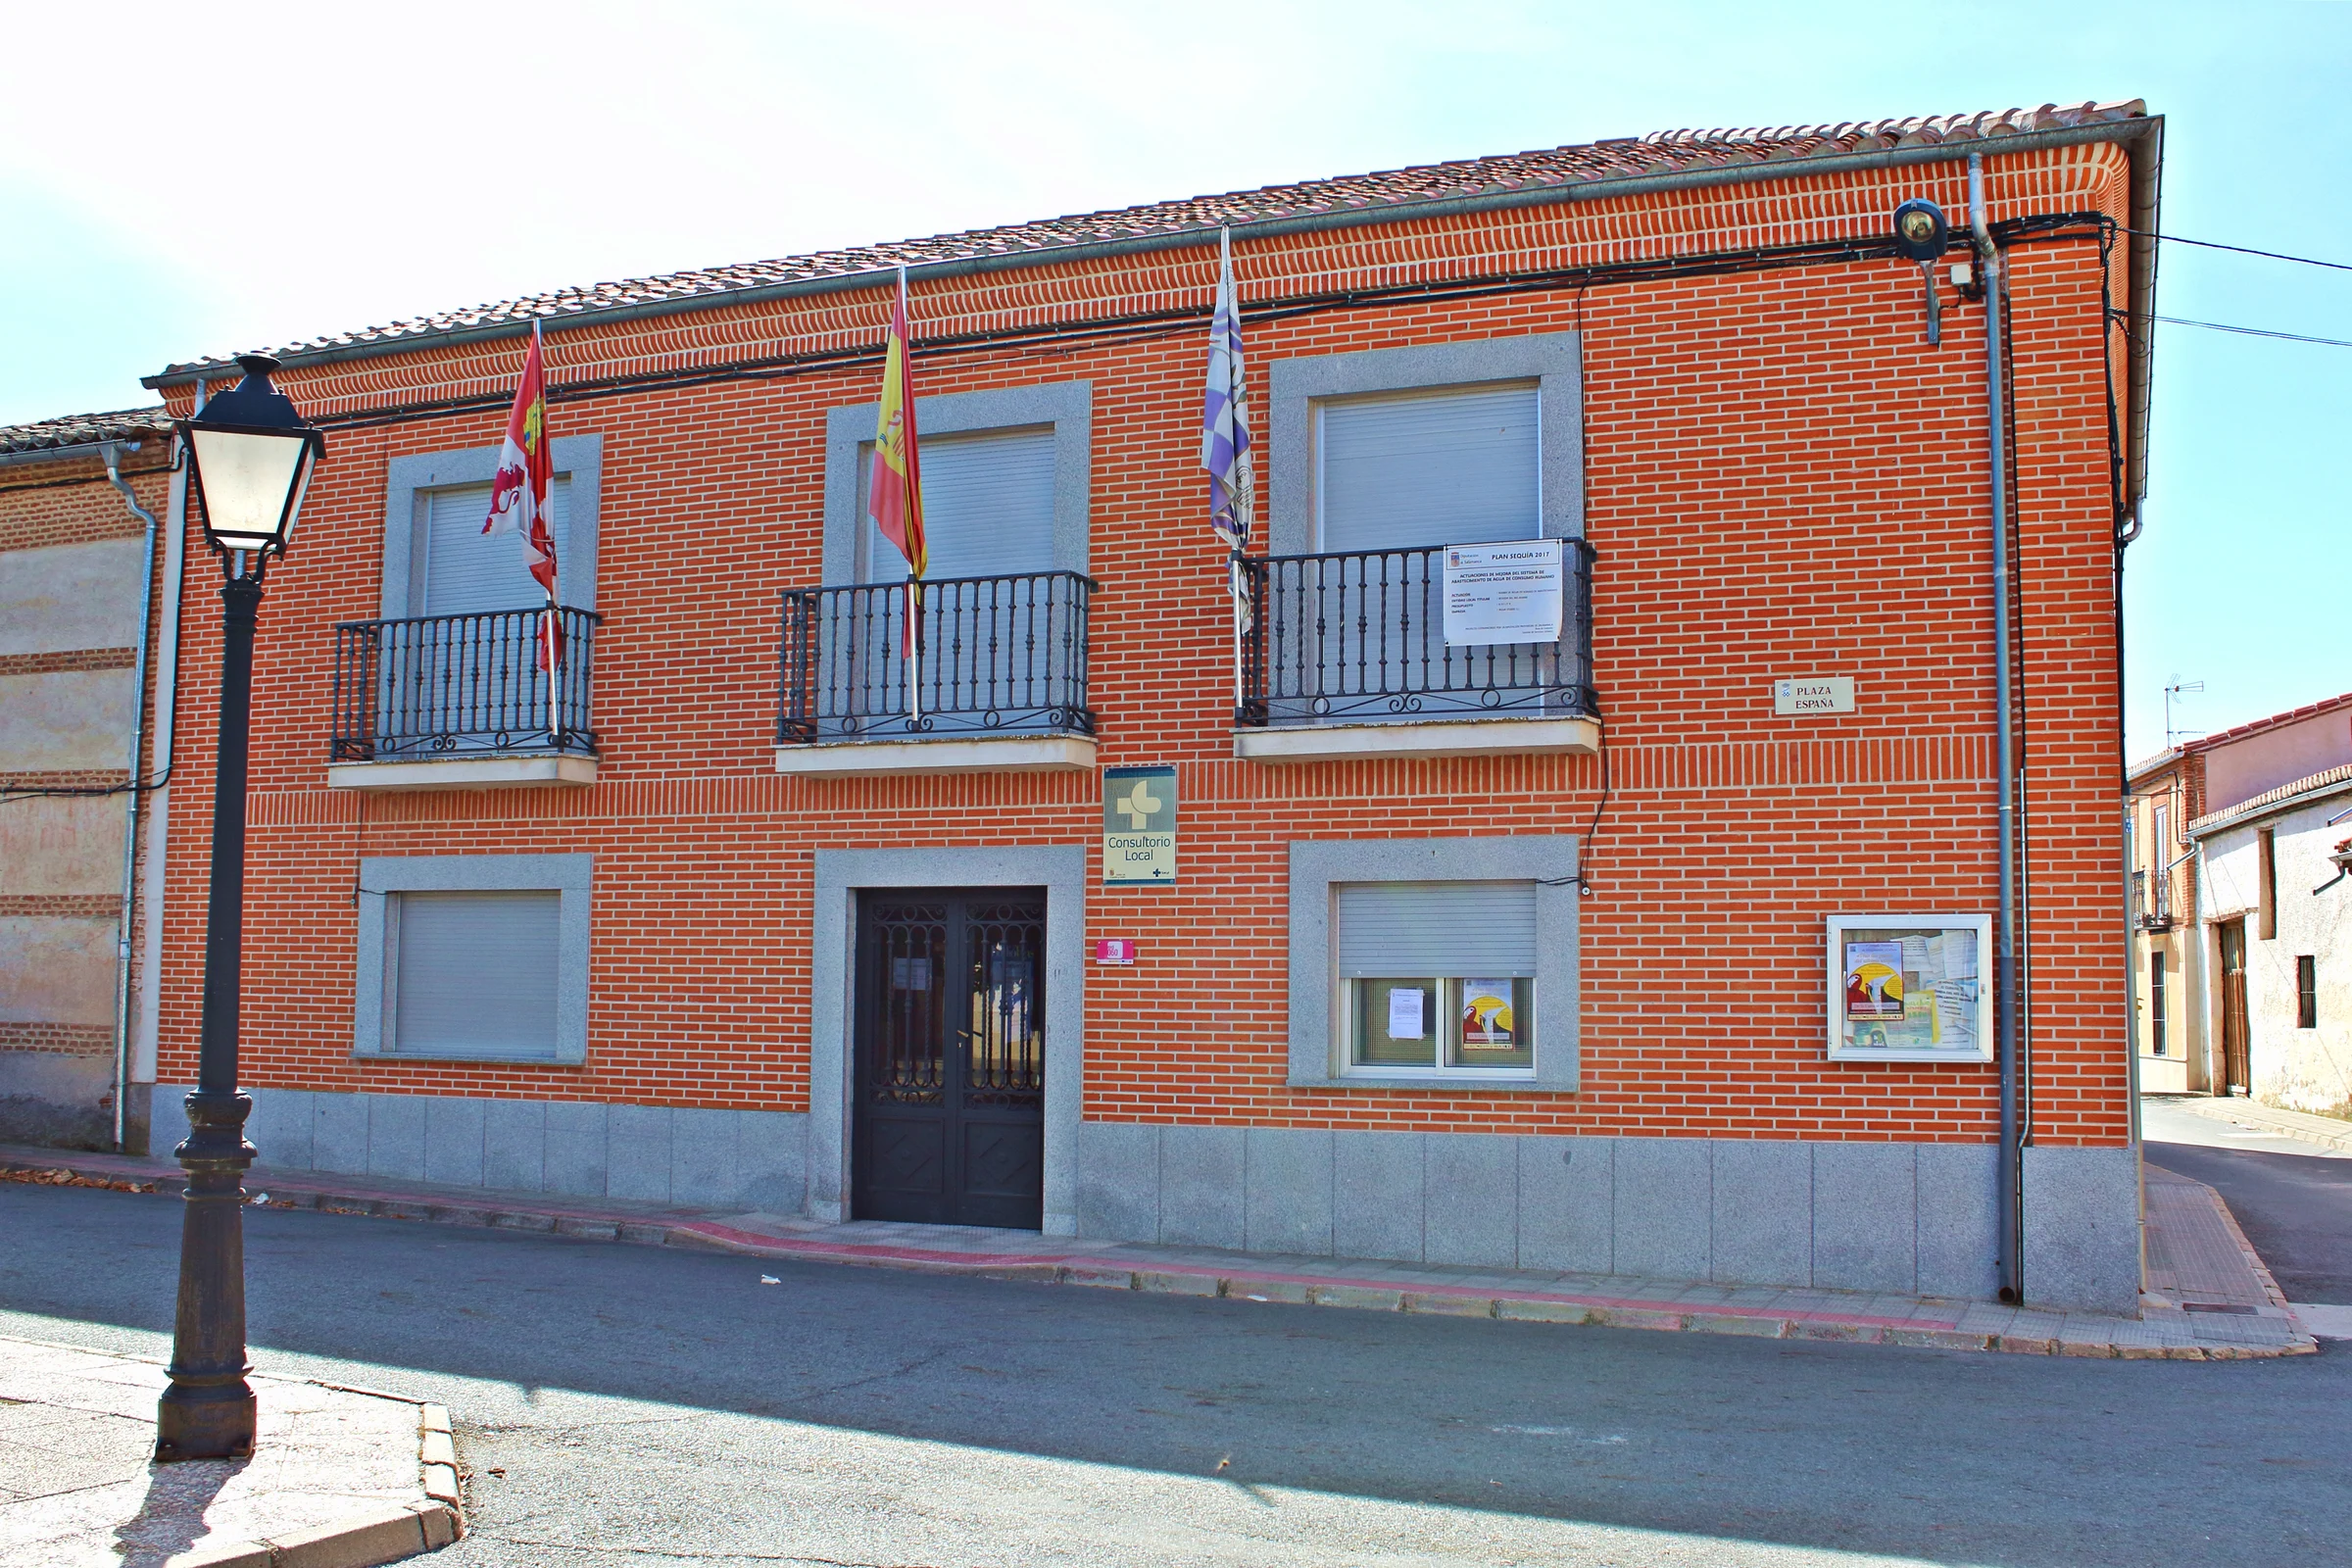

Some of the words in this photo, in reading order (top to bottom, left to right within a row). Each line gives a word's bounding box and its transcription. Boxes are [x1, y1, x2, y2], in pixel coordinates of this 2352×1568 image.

[1796, 686, 1832, 696] PLAZA
[1795, 698, 1834, 710] ESPAÑA
[1108, 836, 1171, 849] Consultorio
[1125, 849, 1153, 861] Local
